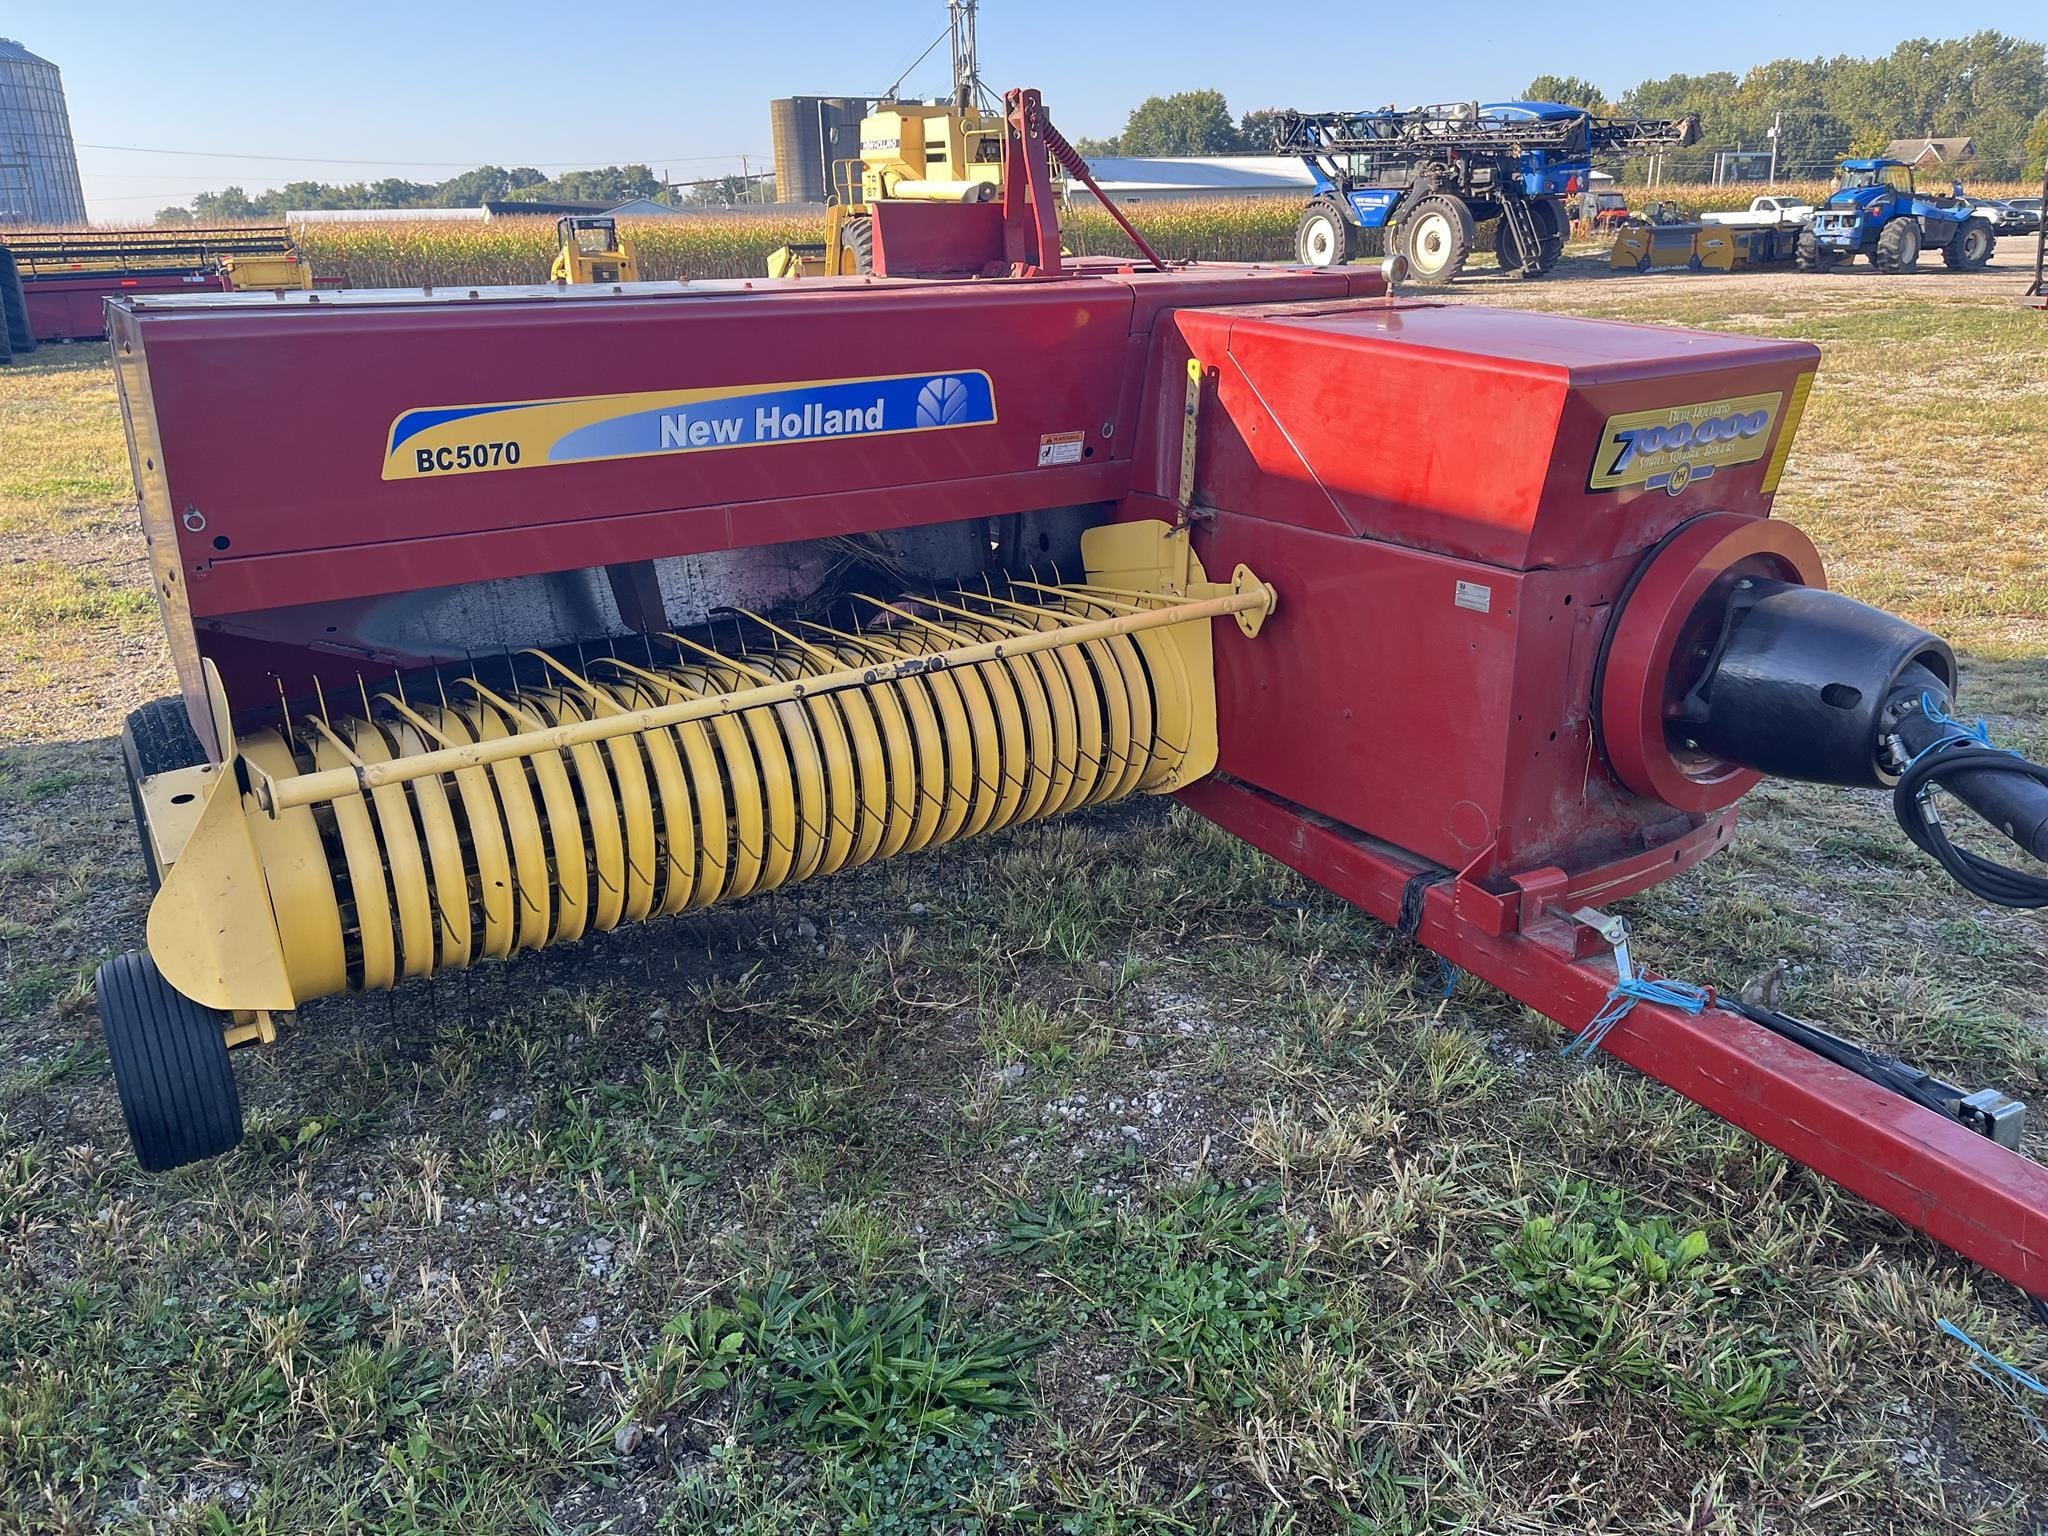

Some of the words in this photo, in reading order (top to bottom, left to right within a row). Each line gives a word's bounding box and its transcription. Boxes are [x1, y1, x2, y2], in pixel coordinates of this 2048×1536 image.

[660, 413, 743, 449] New
[754, 398, 885, 441] Holland
[1606, 409, 1769, 476] 700,000
[416, 441, 520, 472] BC5070
